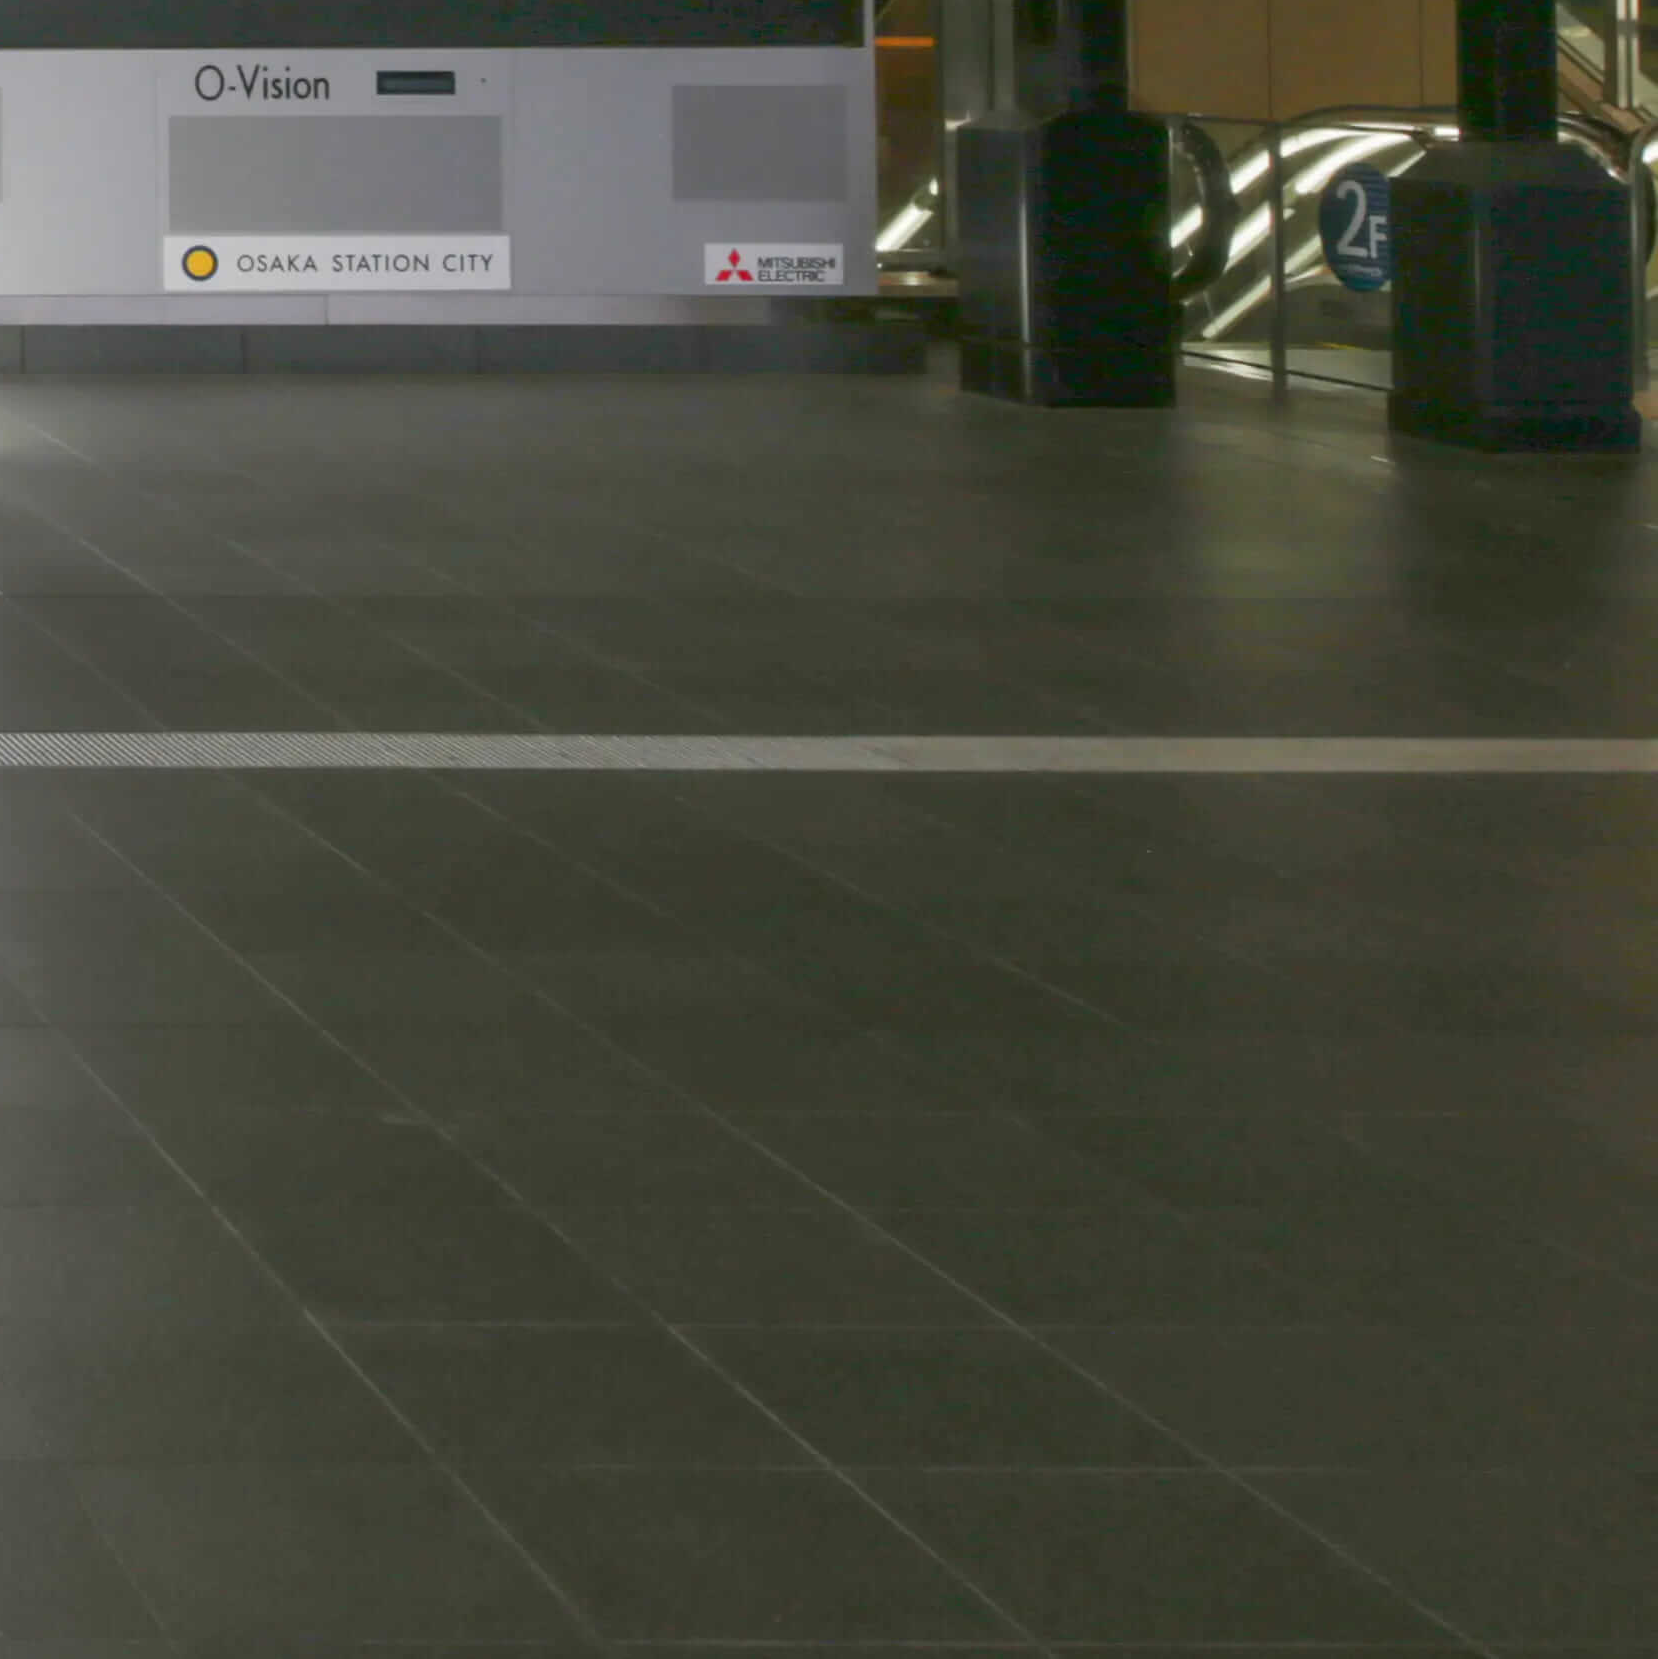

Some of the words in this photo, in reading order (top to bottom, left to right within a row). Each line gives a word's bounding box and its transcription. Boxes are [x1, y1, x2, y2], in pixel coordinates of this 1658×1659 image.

[195, 64, 330, 101] O-Vision
[1336, 180, 1388, 259] 2F
[237, 254, 318, 273] OSAKA
[332, 254, 431, 273] STATION
[442, 254, 494, 273] CITY
[757, 257, 836, 269] MITSUBISHI
[757, 270, 827, 282] ELECTRIC
